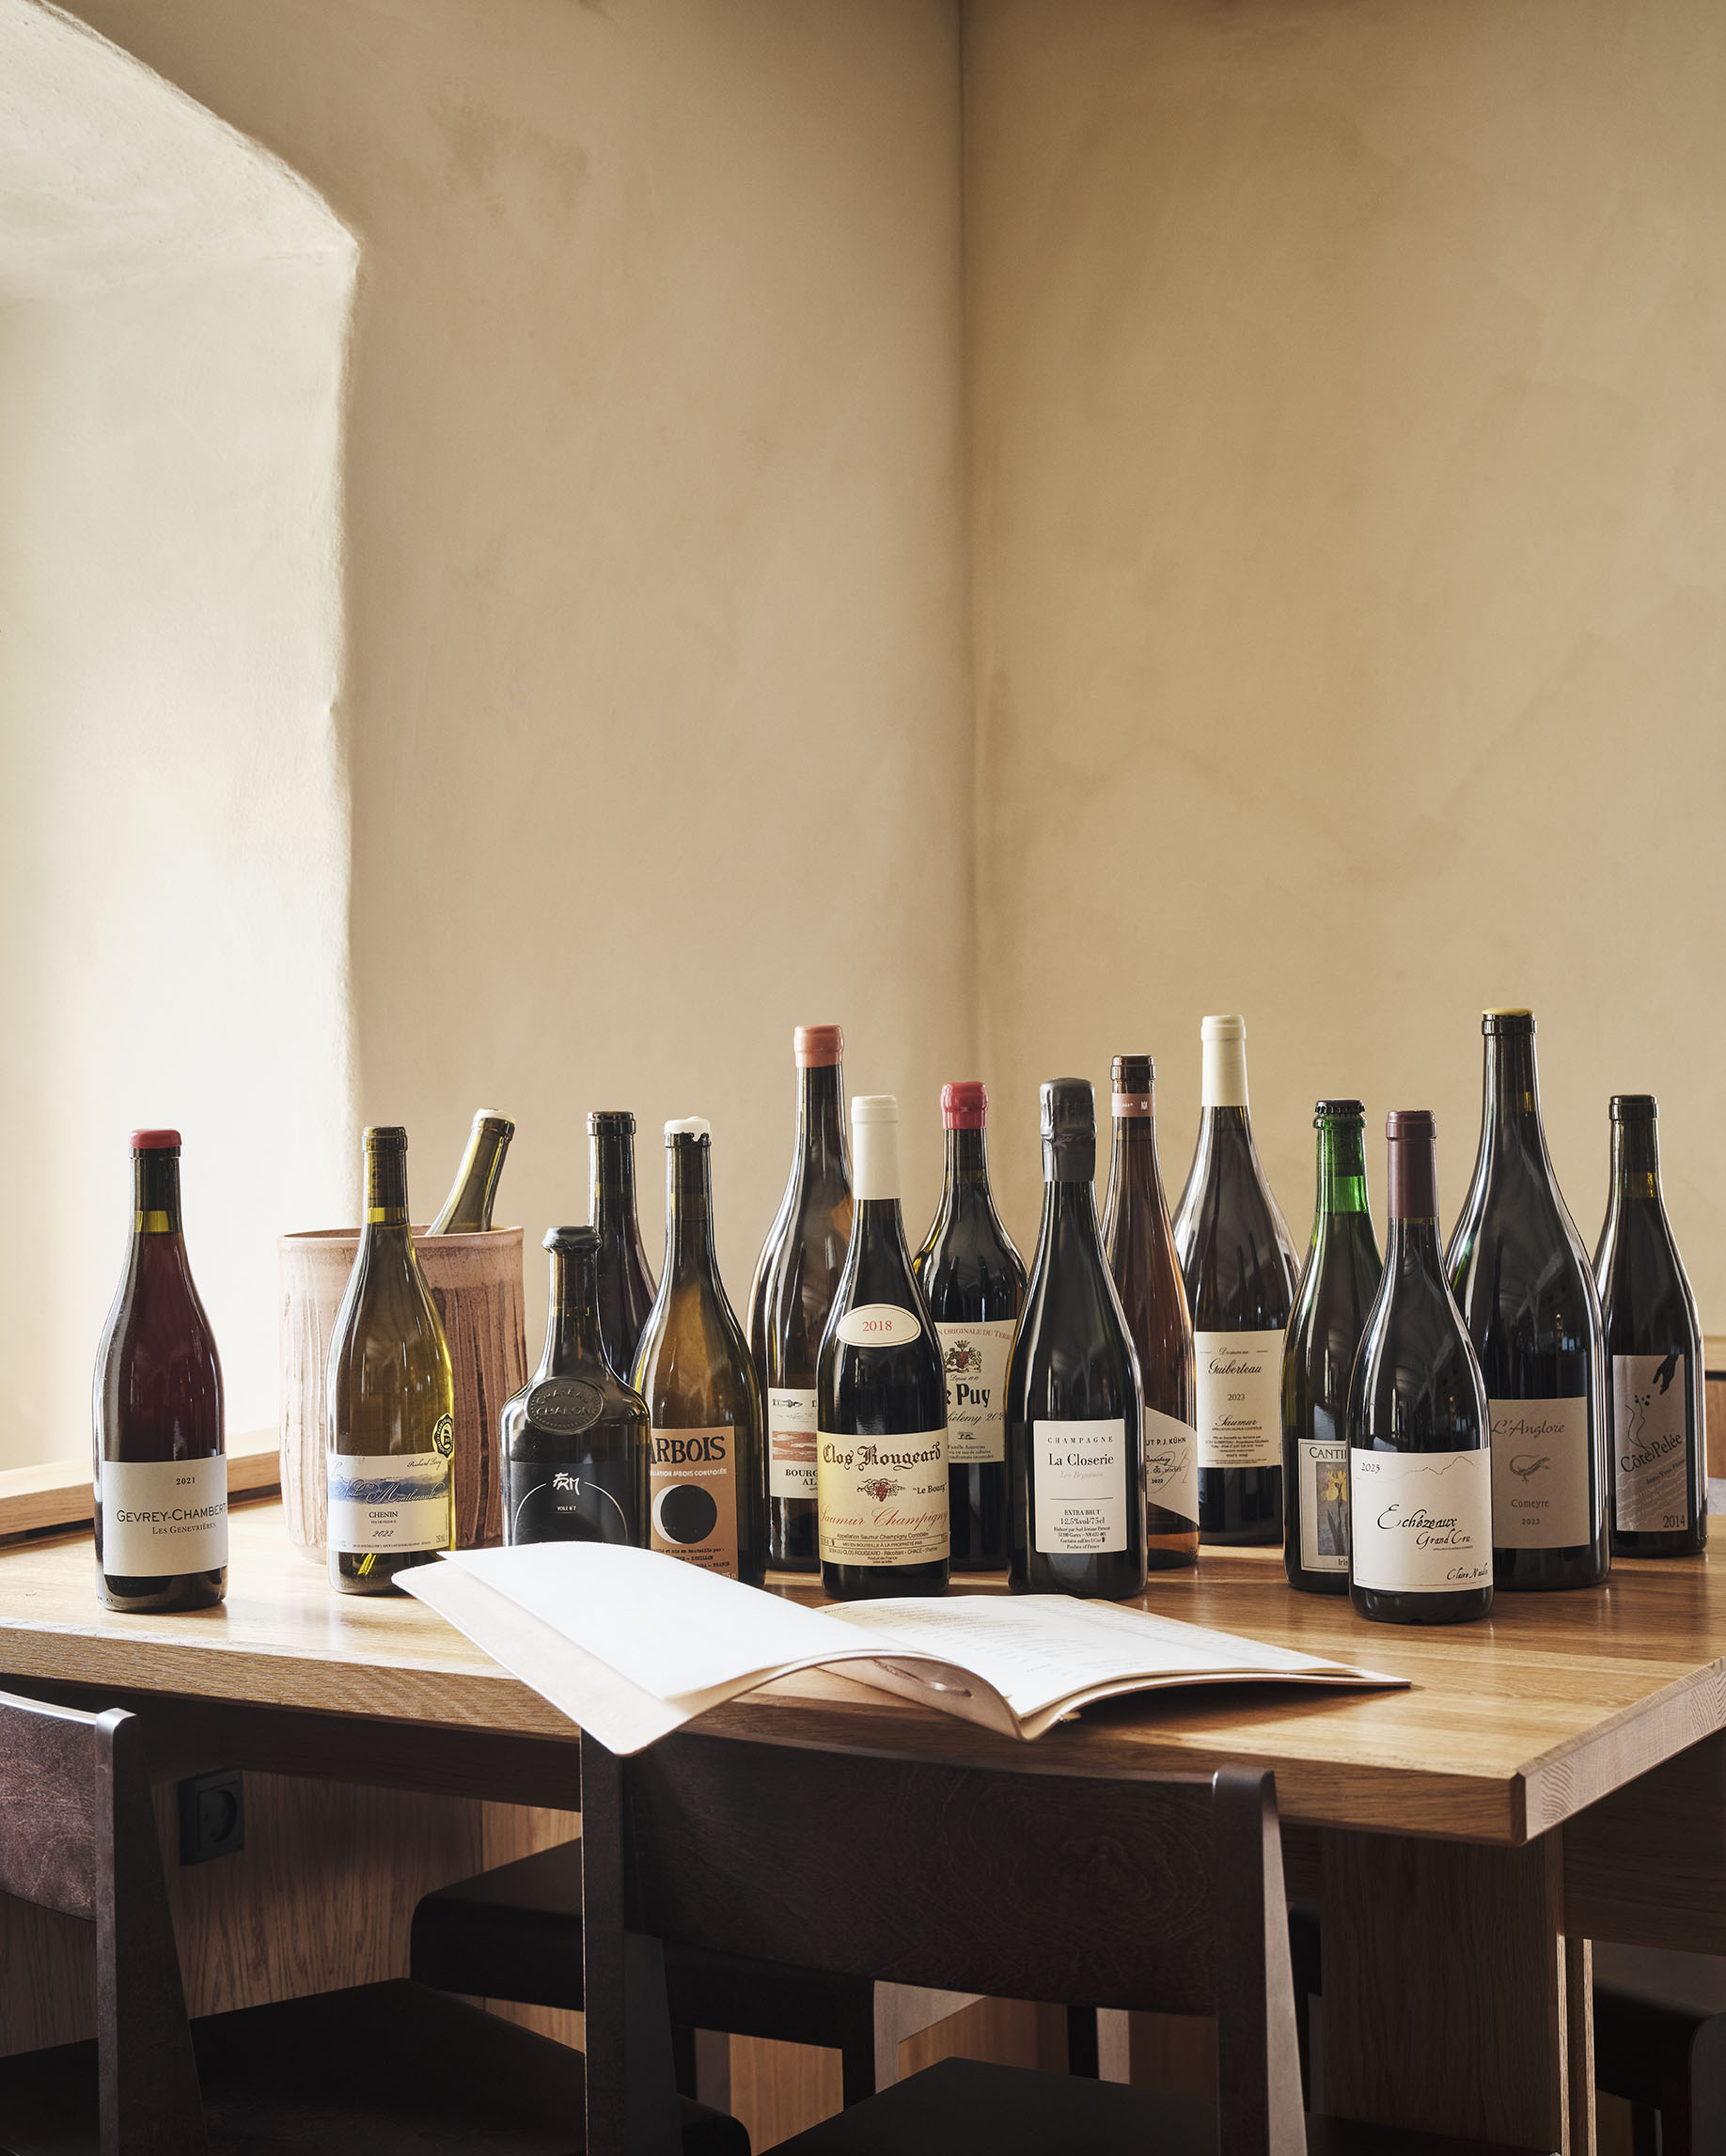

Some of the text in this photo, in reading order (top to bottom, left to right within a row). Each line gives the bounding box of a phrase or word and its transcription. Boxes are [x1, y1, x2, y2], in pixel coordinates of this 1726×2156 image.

[862, 1320, 893, 1332] 2018
[1208, 1358, 1263, 1374] Guiberteau
[956, 1383, 991, 1408] Puy
[1228, 1393, 1246, 1401] 2023
[1215, 1414, 1258, 1428] Saumur
[1491, 1419, 1564, 1439] L'Anglore
[823, 1441, 941, 1471] Clos Rougeard
[1048, 1453, 1114, 1466] La Closerie
[1620, 1434, 1683, 1473] Côte Pelée
[1361, 1462, 1380, 1474] 2023
[176, 1476, 196, 1485] 2021
[1511, 1499, 1549, 1509] Comeyre
[820, 1503, 948, 1531] Saumur Champigny
[1377, 1504, 1457, 1530] Echézeaux
[1662, 1515, 1686, 1528] 2014
[1416, 1528, 1471, 1550] Grand Cru
